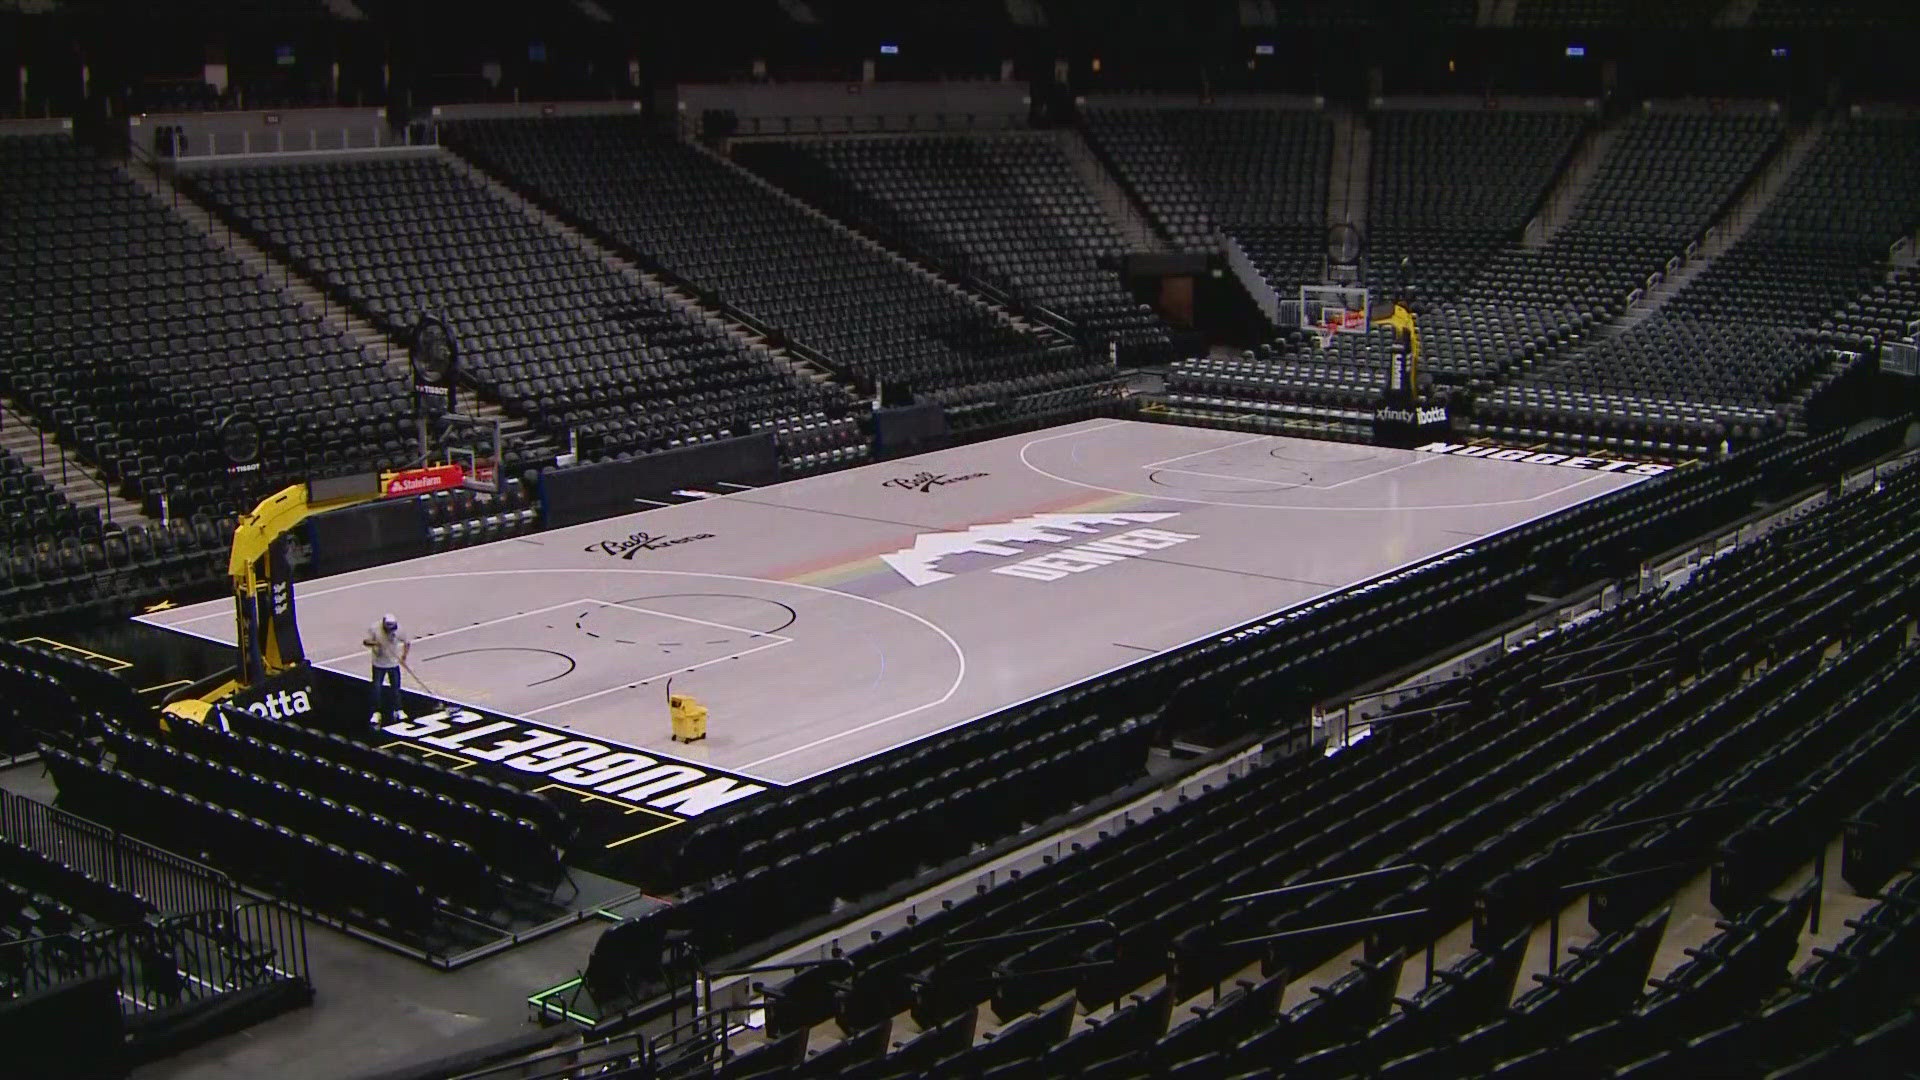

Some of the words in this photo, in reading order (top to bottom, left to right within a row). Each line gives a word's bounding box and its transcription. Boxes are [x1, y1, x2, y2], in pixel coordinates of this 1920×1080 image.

[1376, 406, 1414, 423] xfinity
[1416, 405, 1447, 425] ibotta
[1414, 442, 1677, 476] NUGGETS
[882, 472, 935, 490] Ball
[584, 532, 650, 556] Ball
[990, 528, 1201, 582] DENVER
[216, 686, 312, 733] iotta
[382, 710, 768, 817] NUGGETS
